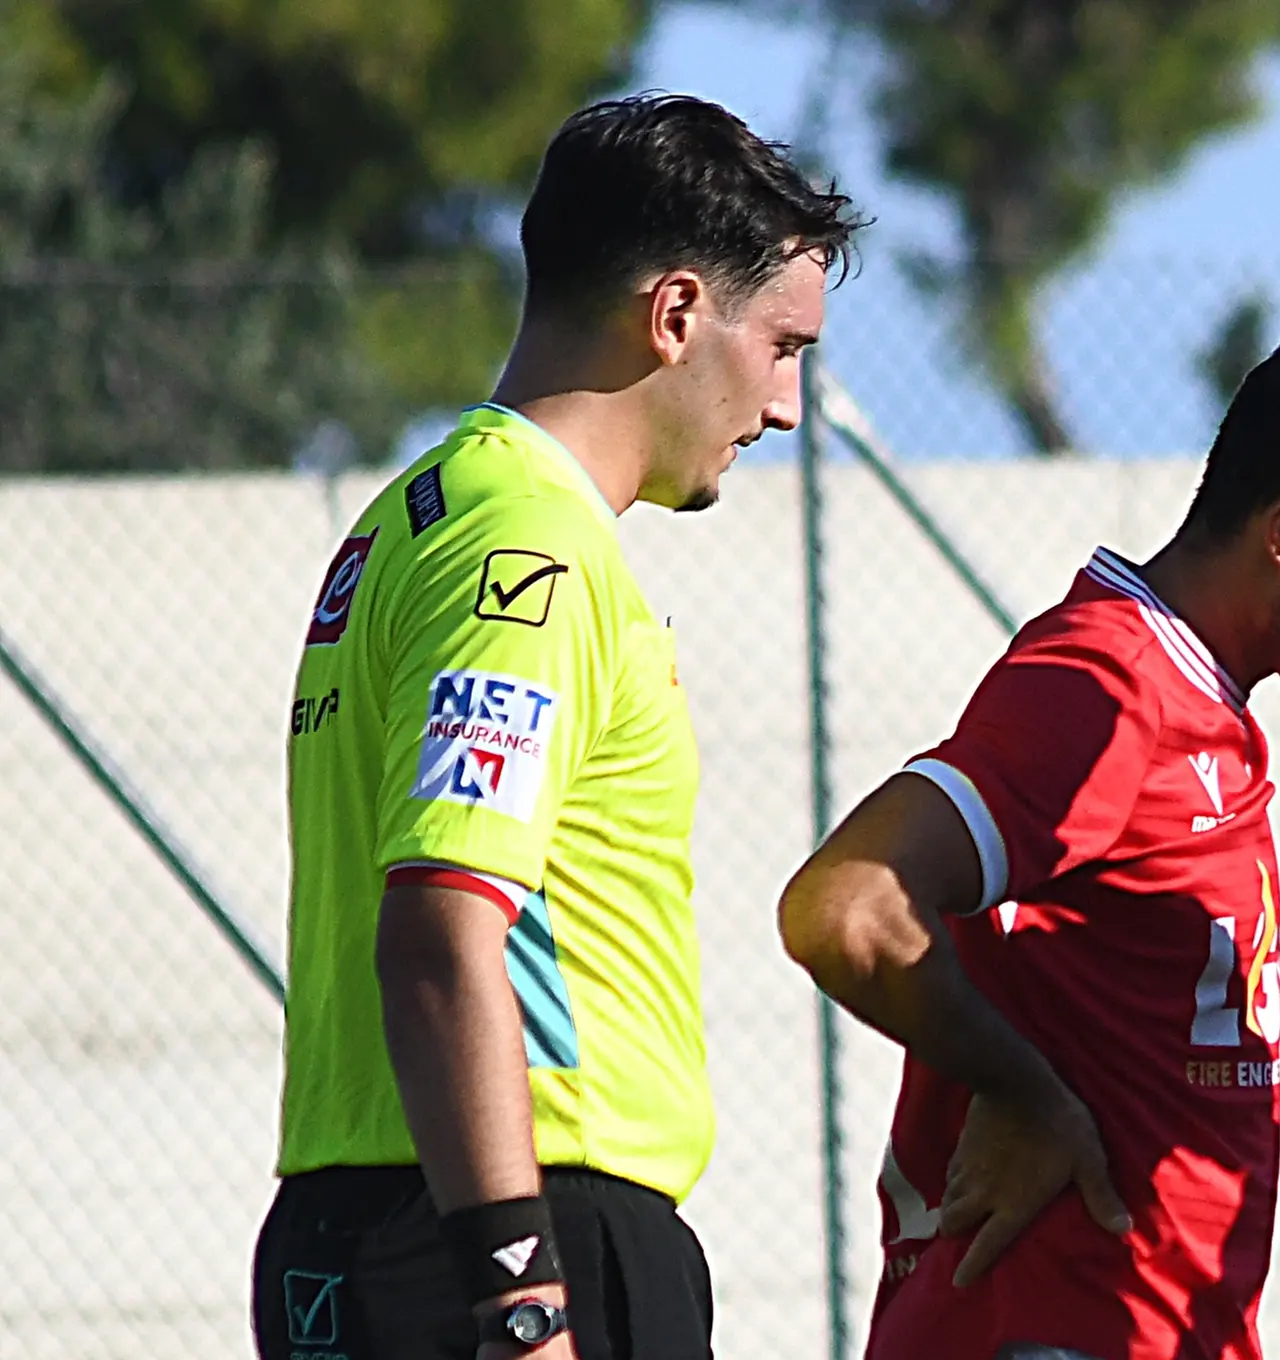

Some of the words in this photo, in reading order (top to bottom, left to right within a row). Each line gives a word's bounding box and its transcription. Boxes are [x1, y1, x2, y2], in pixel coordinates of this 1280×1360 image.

[431, 676, 552, 732] NET
[427, 721, 541, 760] INSURANCE
[1186, 1061, 1231, 1088] FIRE
